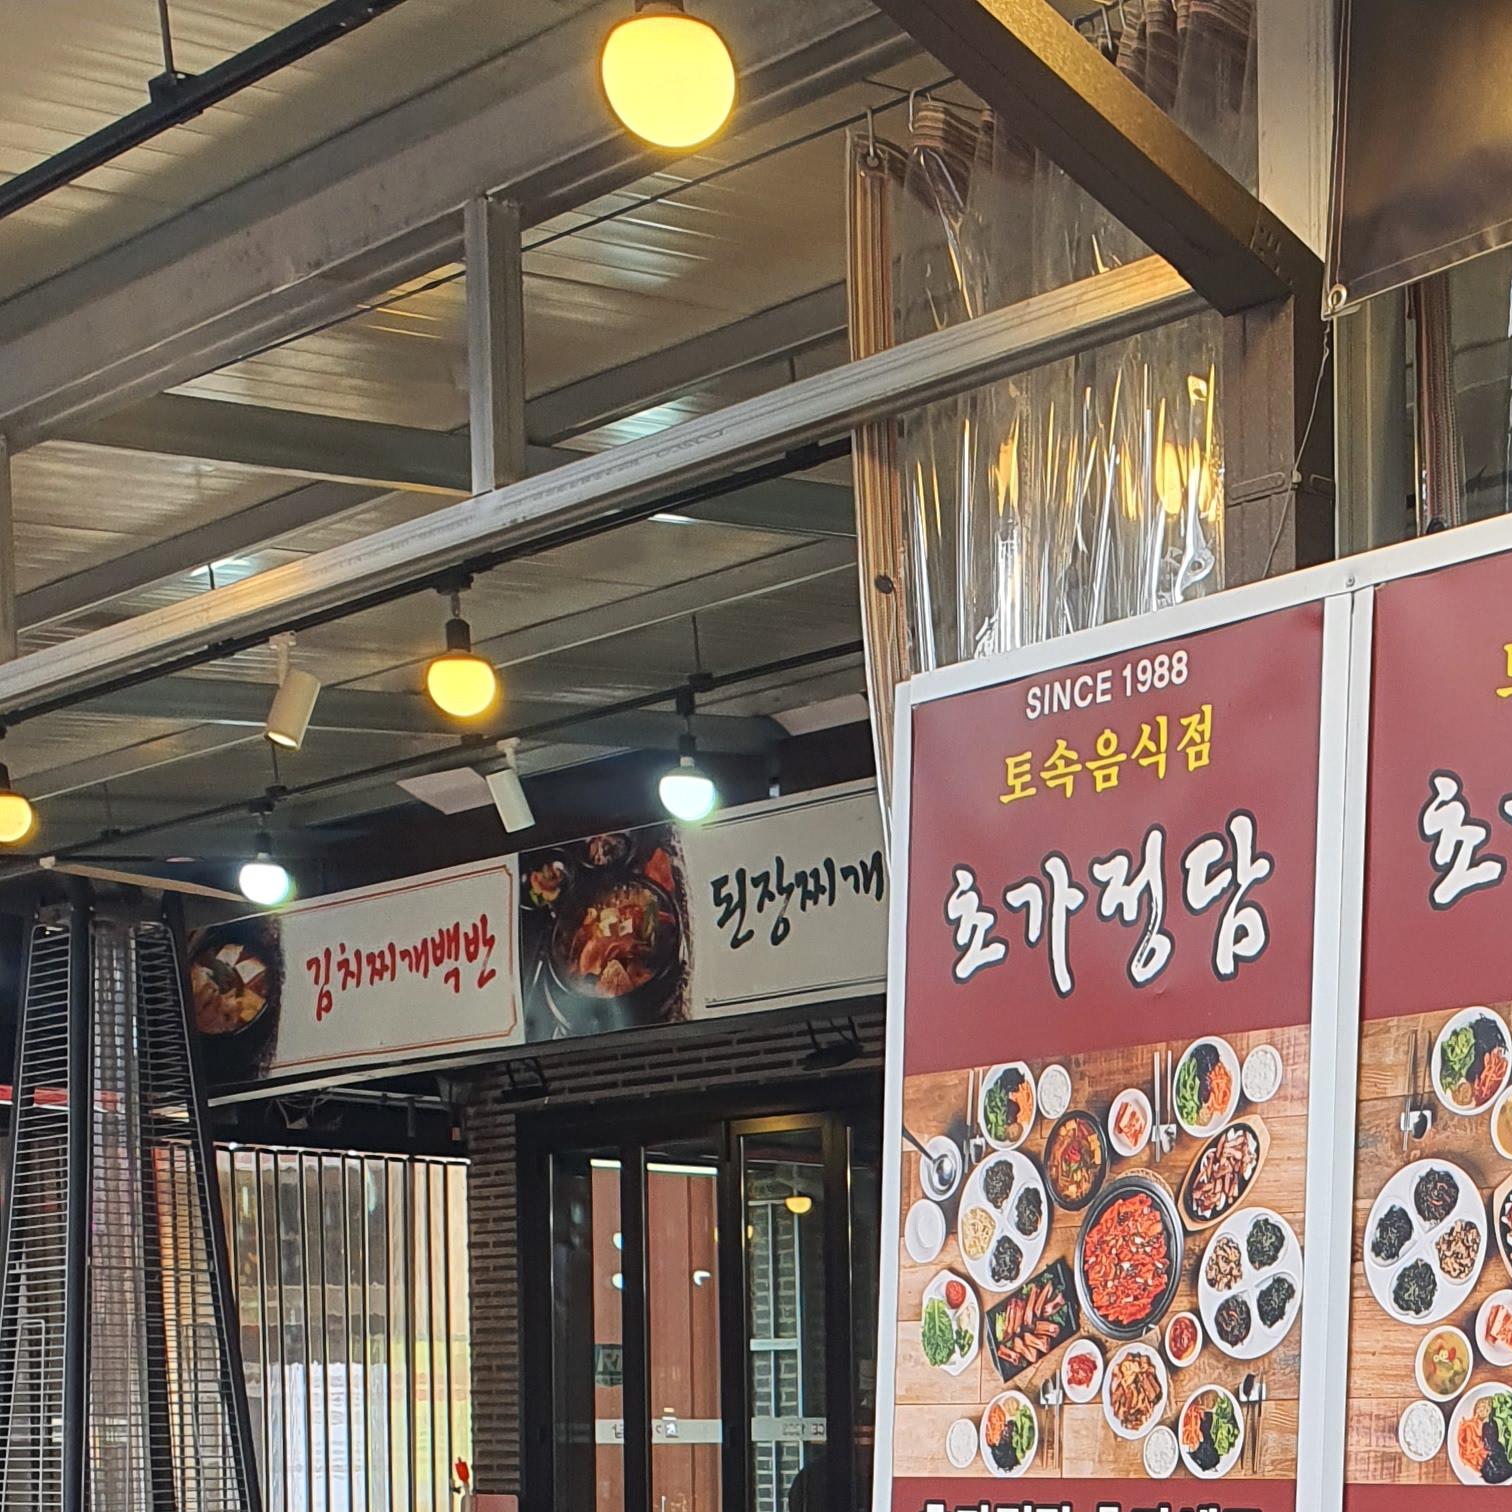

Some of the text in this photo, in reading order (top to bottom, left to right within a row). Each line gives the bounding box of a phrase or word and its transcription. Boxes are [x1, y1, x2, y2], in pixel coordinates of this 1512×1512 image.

[1026, 650, 1189, 720] SINCE 1988
[1000, 704, 1213, 804] 토속음식점
[710, 850, 884, 949] 된장찌개
[946, 812, 1272, 996] 초가정담
[306, 913, 497, 1022] 김치찌개백반
